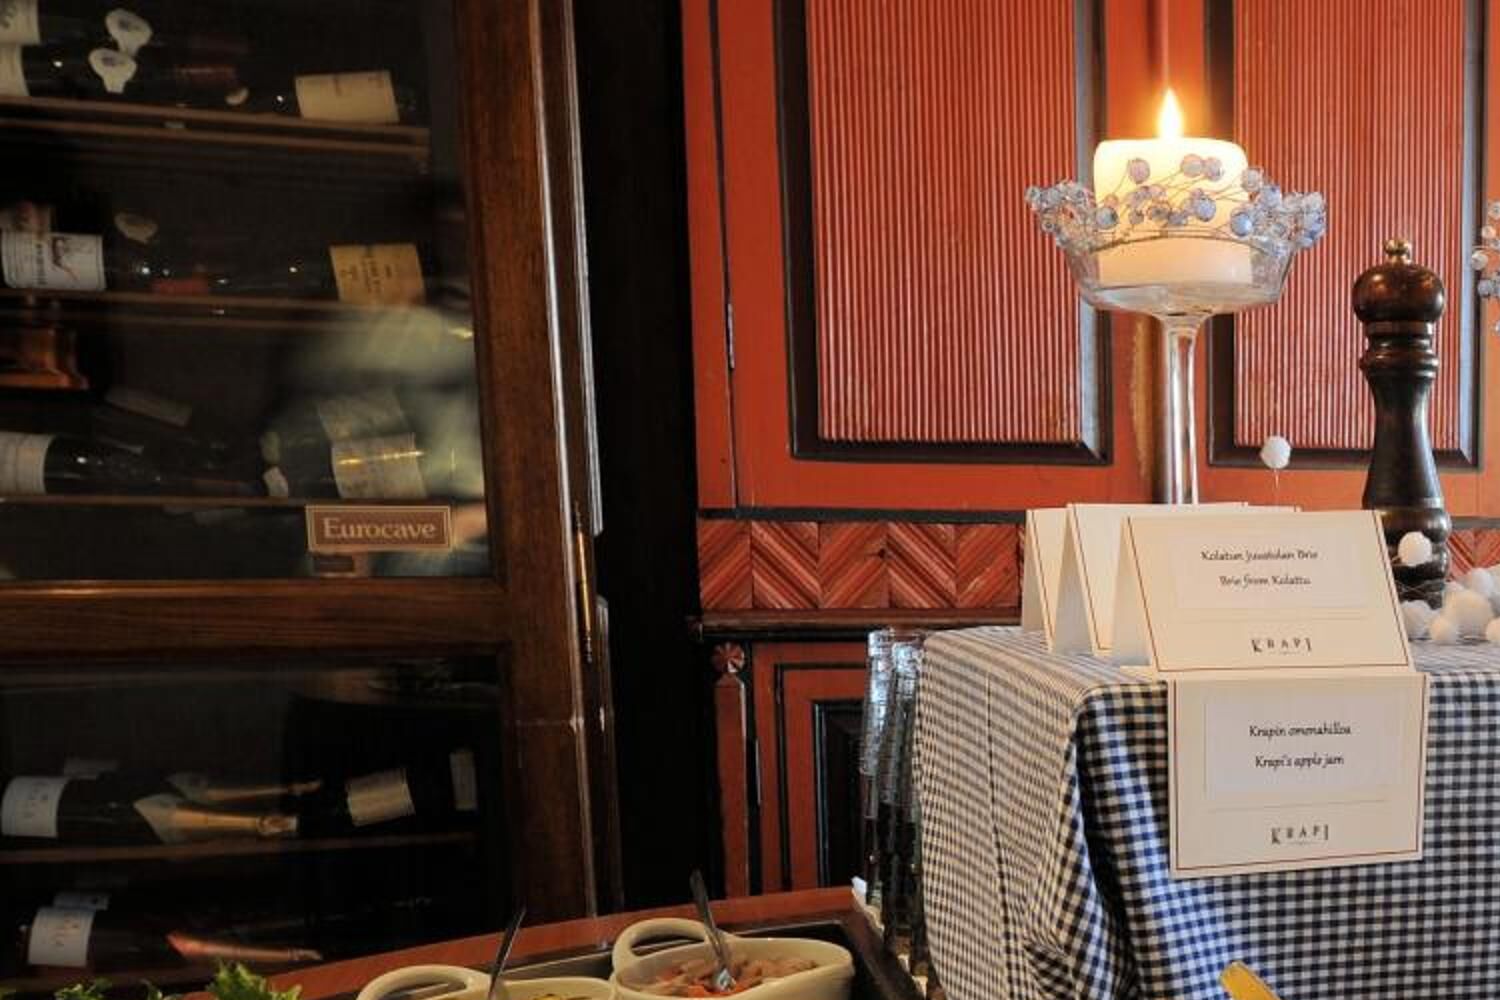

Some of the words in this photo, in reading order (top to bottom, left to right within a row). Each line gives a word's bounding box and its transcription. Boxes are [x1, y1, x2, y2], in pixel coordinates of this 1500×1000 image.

[322, 517, 436, 539] Eurocave
[1242, 573, 1270, 588] from
[1251, 637, 1312, 652] KRAPI
[1249, 725, 1287, 740] Krapin
[1255, 755, 1293, 770] Krapi's
[1294, 753, 1322, 770] apple
[1322, 754, 1345, 768] jam
[1271, 824, 1329, 845] KRAPI
